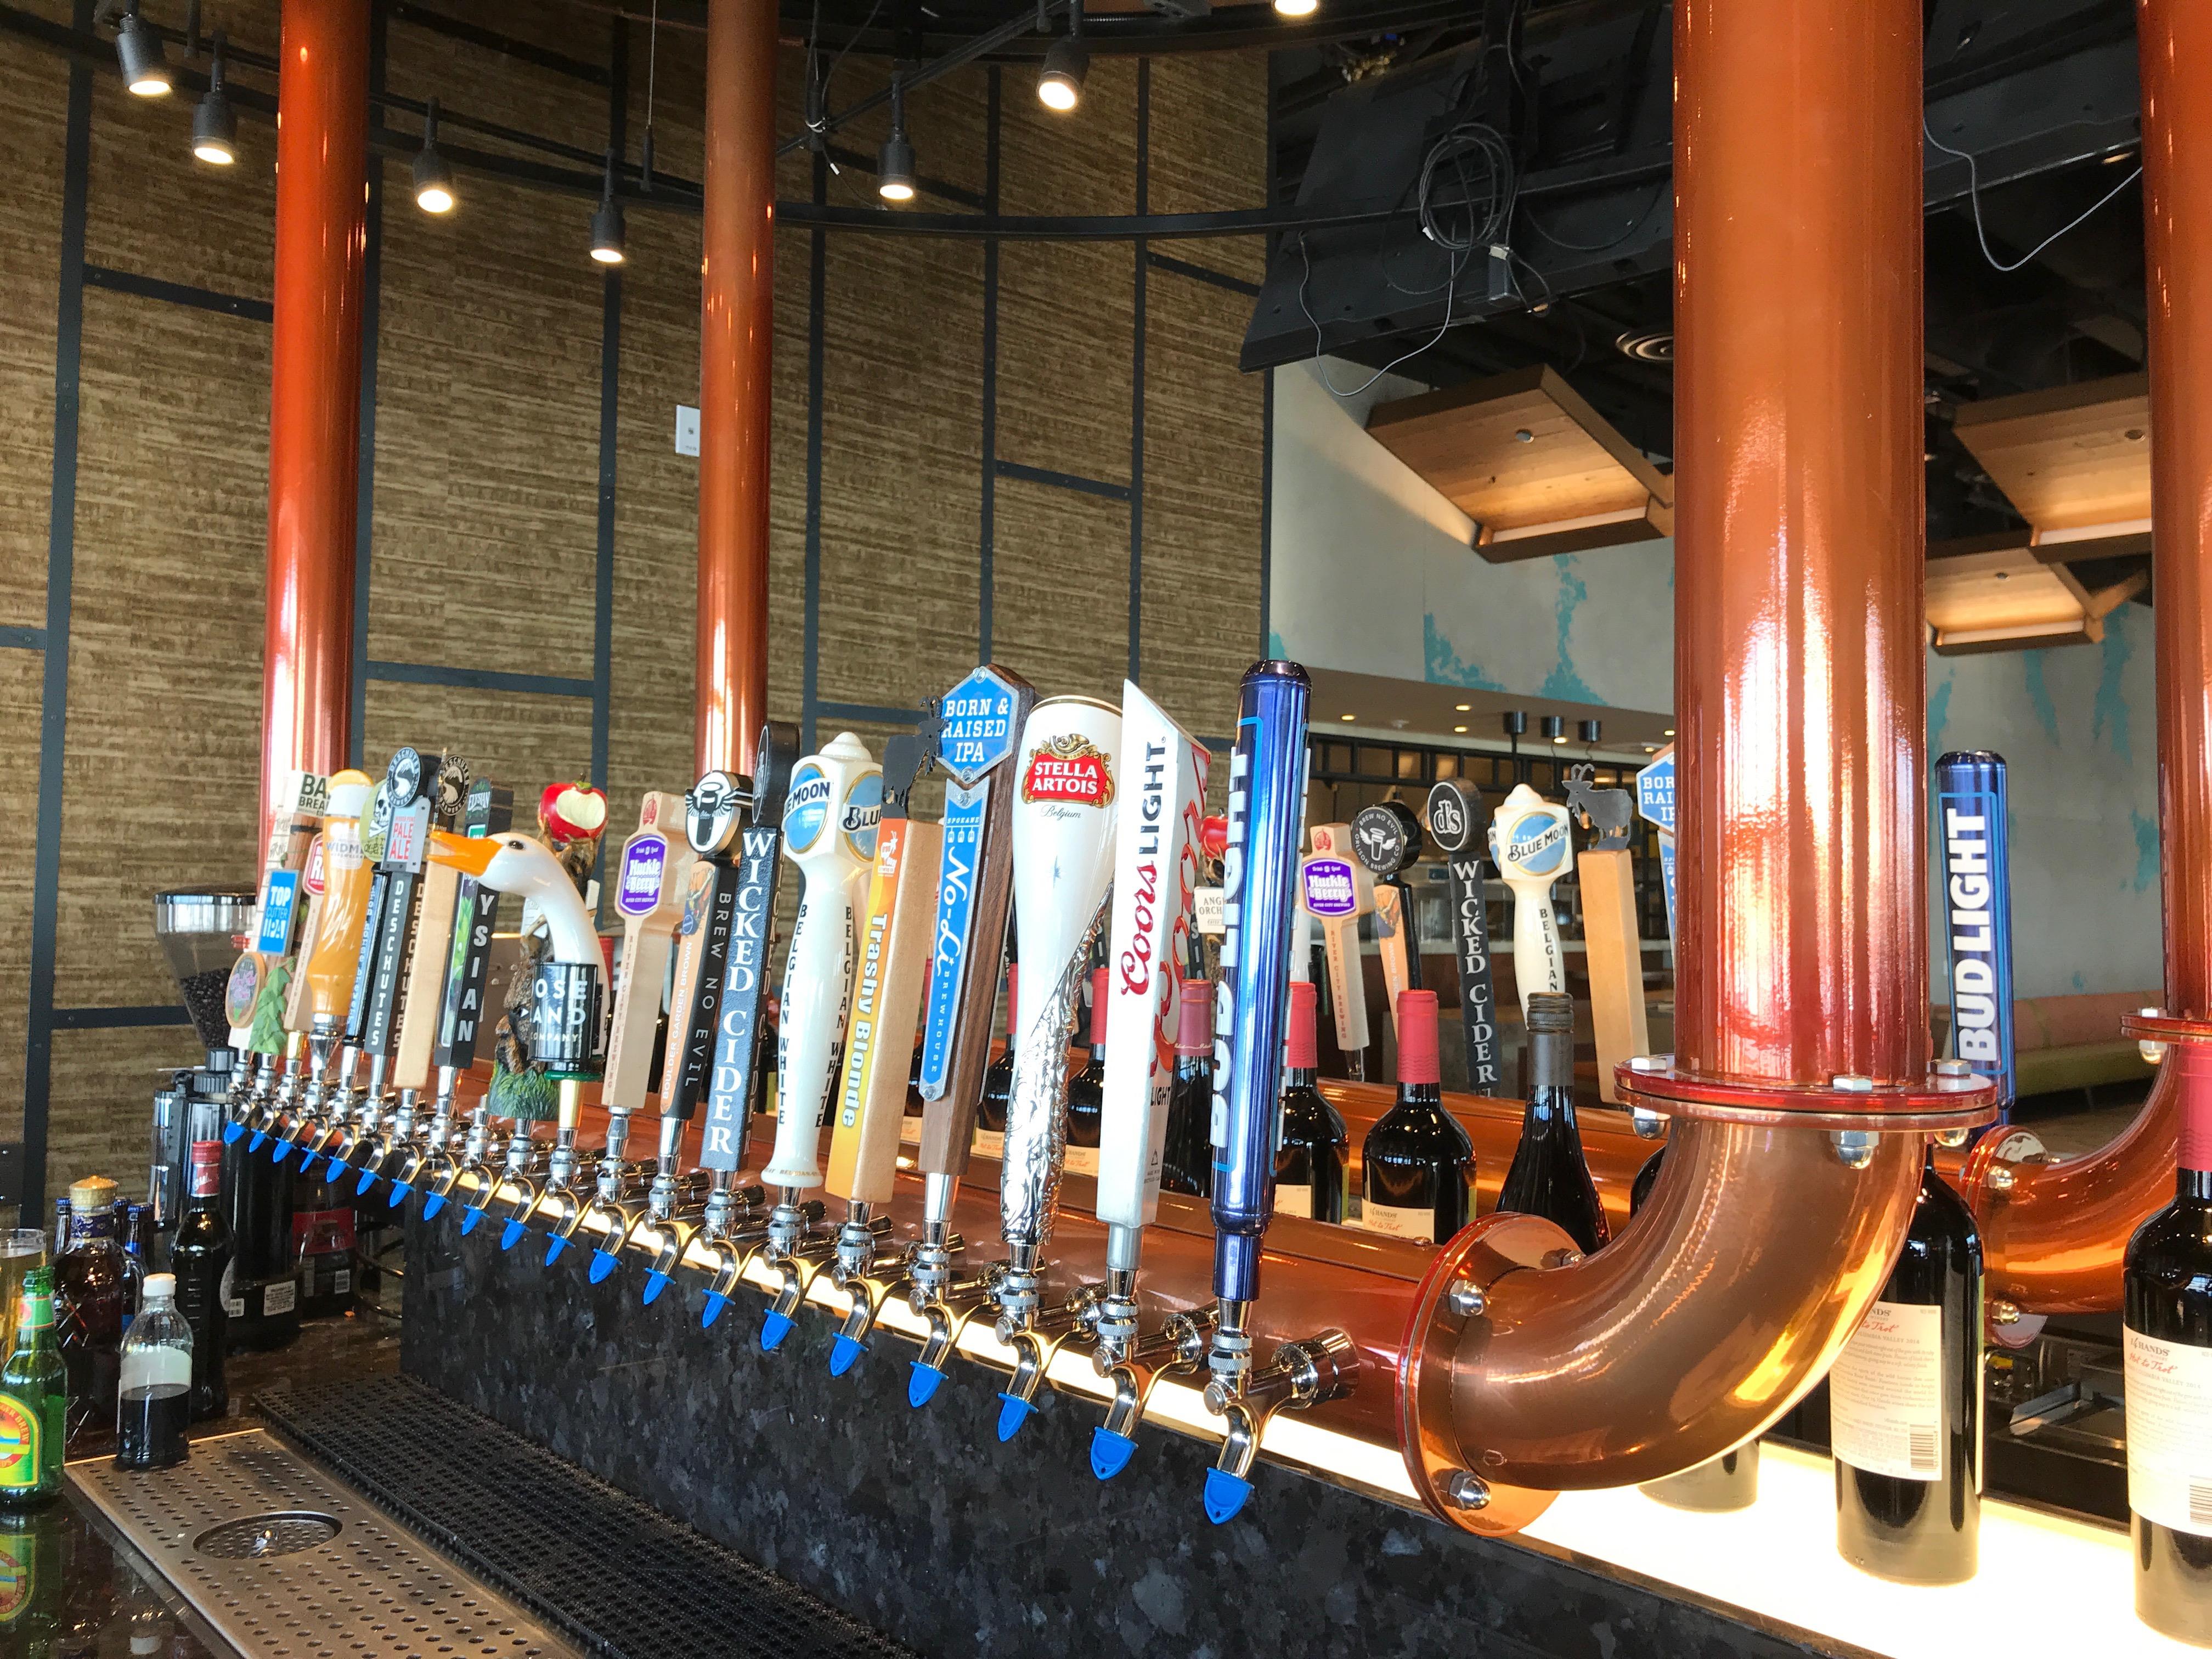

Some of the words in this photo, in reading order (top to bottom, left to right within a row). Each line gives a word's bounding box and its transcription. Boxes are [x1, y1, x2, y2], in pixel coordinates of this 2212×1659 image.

[944, 698, 992, 717] BORN
[997, 697, 1009, 715] &
[941, 719, 1006, 738] RAISED
[954, 742, 985, 762] IPA
[1035, 762, 1098, 779] STELLA
[1643, 776, 1674, 789] BOR
[302, 774, 331, 800] BA
[792, 781, 831, 806] MOON
[1032, 778, 1097, 795] ARTOIS
[1138, 741, 1165, 854] LIGHT
[1644, 792, 1674, 805] RAI
[467, 791, 491, 812] ELYSIAN
[1041, 804, 1082, 821] Belgium
[843, 806, 882, 831] BLU
[1376, 813, 1386, 821] NO
[392, 823, 414, 839] PALE
[1508, 839, 1543, 862] BLUE
[1544, 824, 1569, 846] MOON
[389, 840, 411, 860] ALE
[1308, 874, 1350, 888] Huckle
[1946, 808, 1991, 952] LIGHT
[270, 885, 292, 906] TOP
[1203, 896, 1227, 906] ANG
[266, 906, 289, 919] CUTTER
[726, 832, 777, 992] WICKED
[1199, 906, 1222, 915] ORCH
[1453, 860, 1486, 975] WICKED
[711, 893, 732, 959] BREW
[1121, 860, 1157, 995] Coors
[1539, 908, 1558, 992] BELGIAN
[371, 880, 405, 1046] DESCHUTES
[458, 894, 495, 1042] YSIAN
[781, 904, 808, 1025] BELGIAN
[836, 906, 853, 1030] BELGIAN
[857, 913, 888, 1014] Trashy
[535, 978, 588, 1000] OSE
[702, 977, 719, 1009] NO
[533, 1005, 586, 1025] AND
[662, 1042, 678, 1099] BOULDER
[673, 989, 686, 1039] GARDEN
[680, 941, 693, 986] BROWN
[931, 970, 950, 1073] BREWHOUSE
[1954, 958, 1997, 1062] BUD
[1469, 983, 1497, 1085] CIDER
[685, 1029, 709, 1087] EVIL
[708, 1010, 747, 1154] CIDER
[778, 1036, 788, 1125] WHITE
[815, 1041, 840, 1129] WHITE
[842, 1019, 872, 1128] Blonde
[1150, 1086, 1171, 1107] LIGHT
[1870, 1308, 1891, 1317] NDS
[1871, 1321, 1895, 1333] Trot
[2137, 1341, 2170, 1357] HANDS
[2141, 1358, 2150, 1368] to
[2151, 1360, 2176, 1374] Trot
